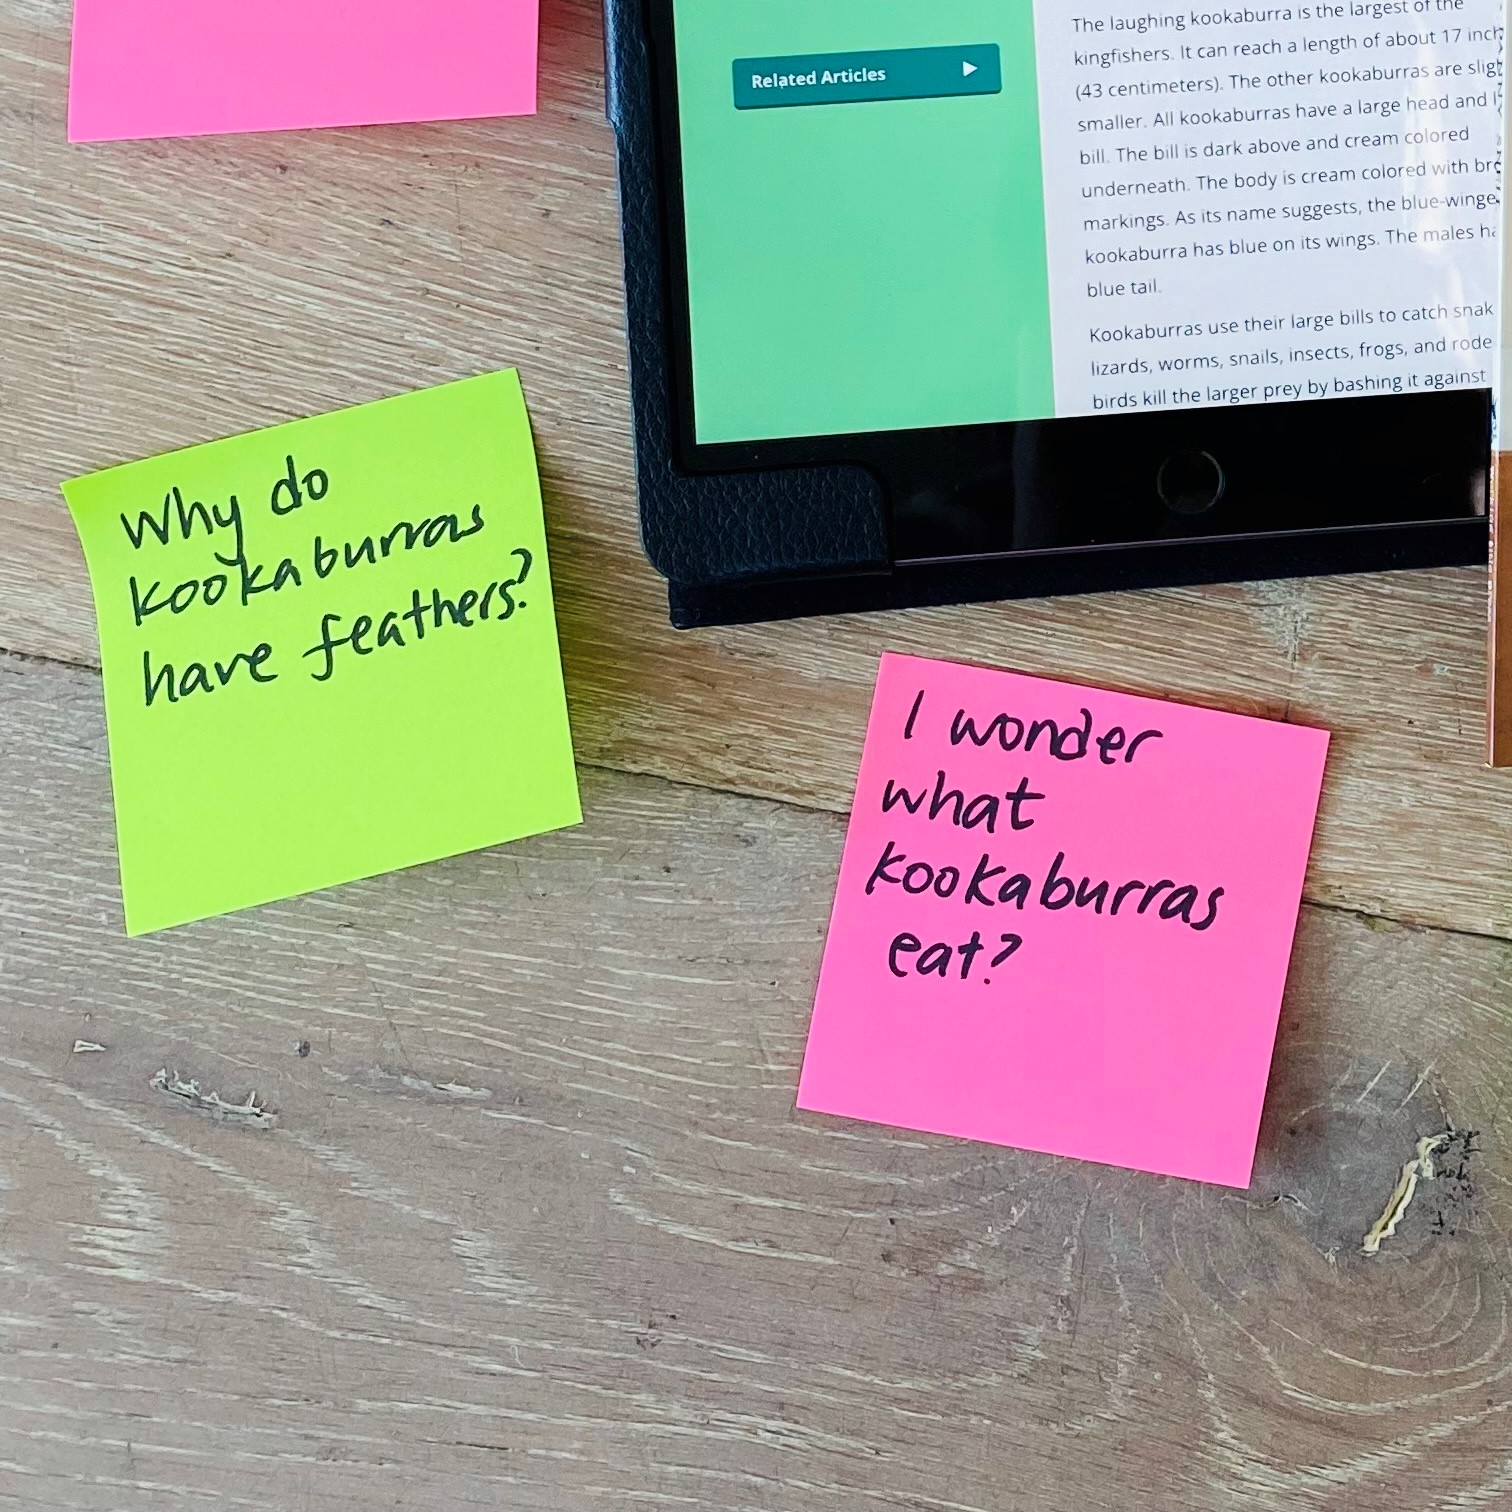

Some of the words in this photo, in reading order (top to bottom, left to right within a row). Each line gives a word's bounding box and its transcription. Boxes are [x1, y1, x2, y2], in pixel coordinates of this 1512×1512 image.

[751, 70, 816, 88] Related
[820, 67, 885, 84] Articles
[1093, 392, 1137, 409] birds
[1143, 389, 1165, 405] kill
[1172, 388, 1200, 403] the
[1206, 386, 1256, 403] larger
[1263, 384, 1301, 401] prey
[1308, 379, 1327, 397] by
[1333, 375, 1402, 392] bashing
[1408, 374, 1418, 386] it
[120, 487, 245, 566] Why
[271, 455, 328, 516] do
[130, 504, 484, 625] kookaburras
[144, 641, 278, 706] have
[302, 548, 532, 681] feathers?
[904, 690, 924, 739] I
[950, 708, 1163, 765] wonder
[882, 771, 1045, 833] what
[865, 841, 1225, 930] kookaburras
[888, 931, 1022, 984] eat?
